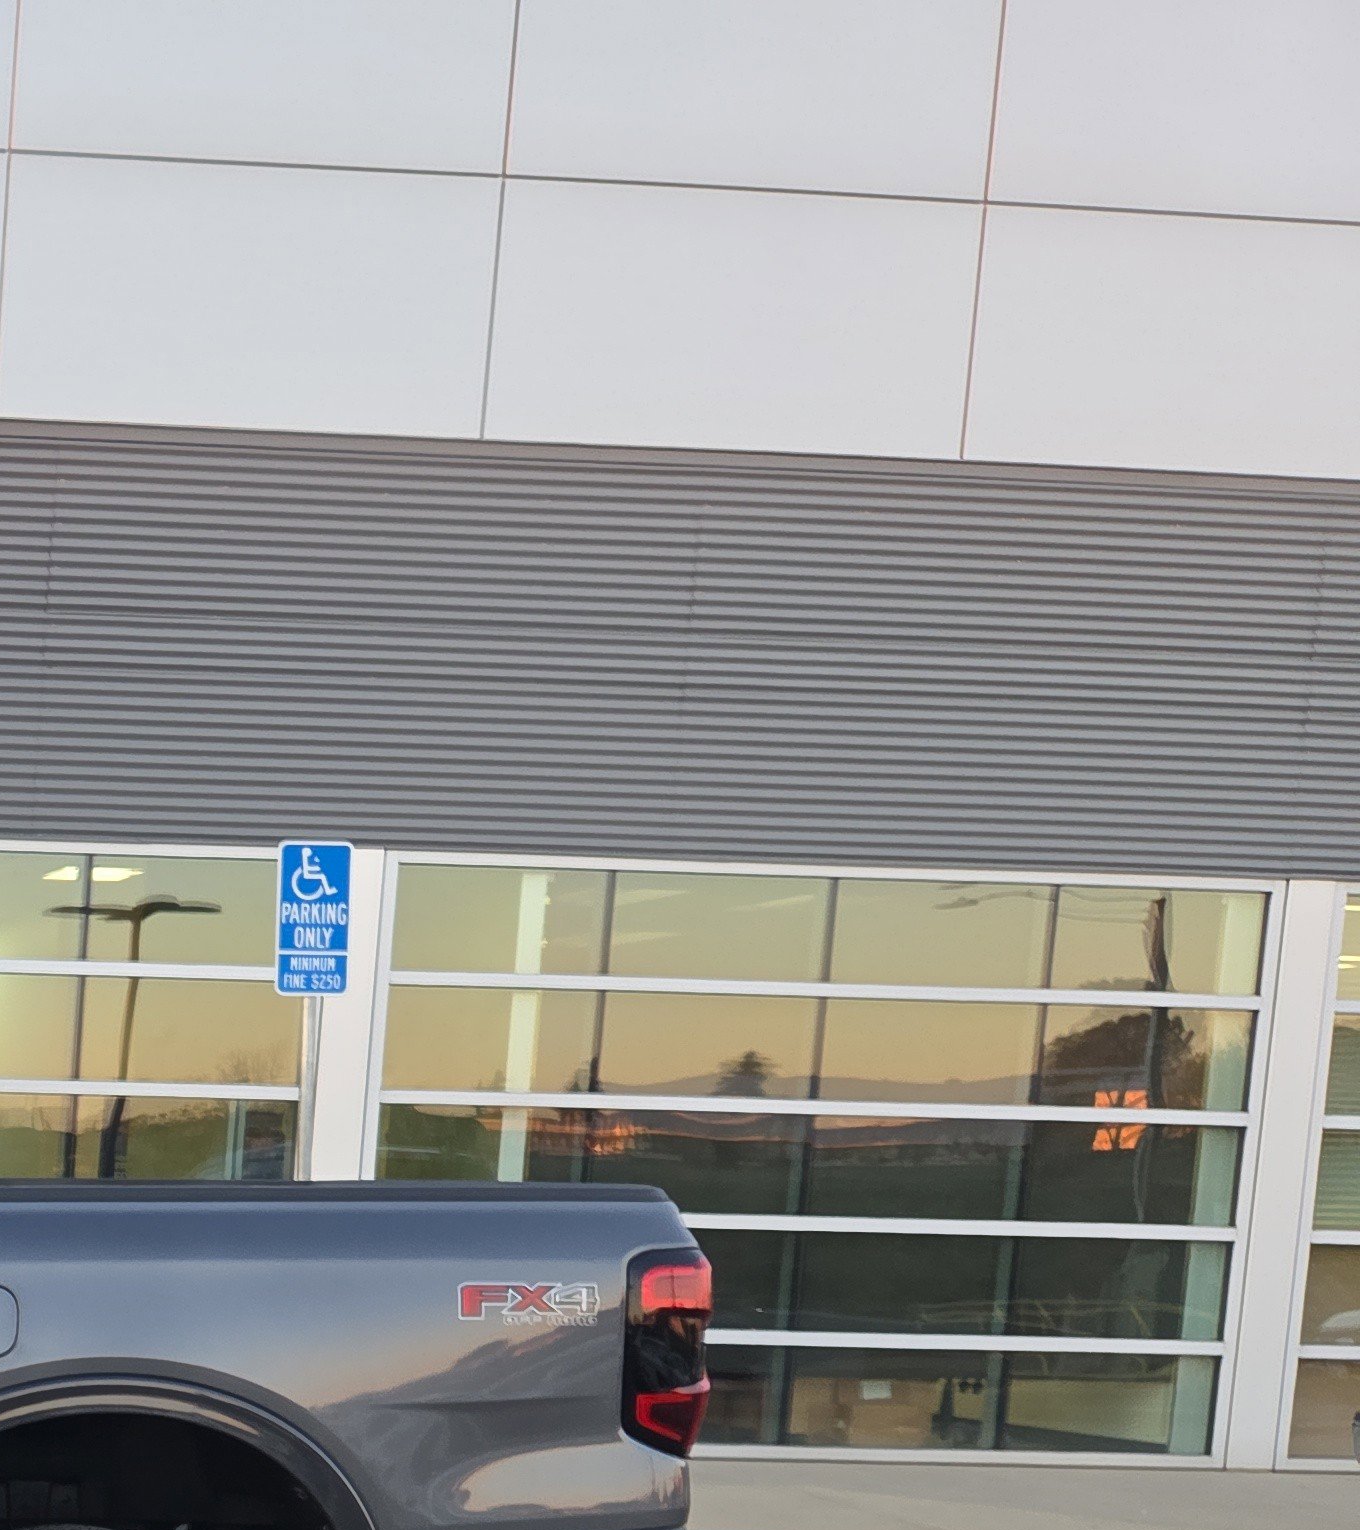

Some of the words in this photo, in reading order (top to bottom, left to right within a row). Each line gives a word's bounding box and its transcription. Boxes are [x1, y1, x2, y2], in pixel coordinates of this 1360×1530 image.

[281, 901, 347, 926] PARKING
[294, 926, 334, 949] ONLY
[290, 956, 336, 972] MINIMUM
[283, 972, 308, 989] FINE
[311, 973, 341, 990] $250
[458, 1282, 600, 1320] FX4
